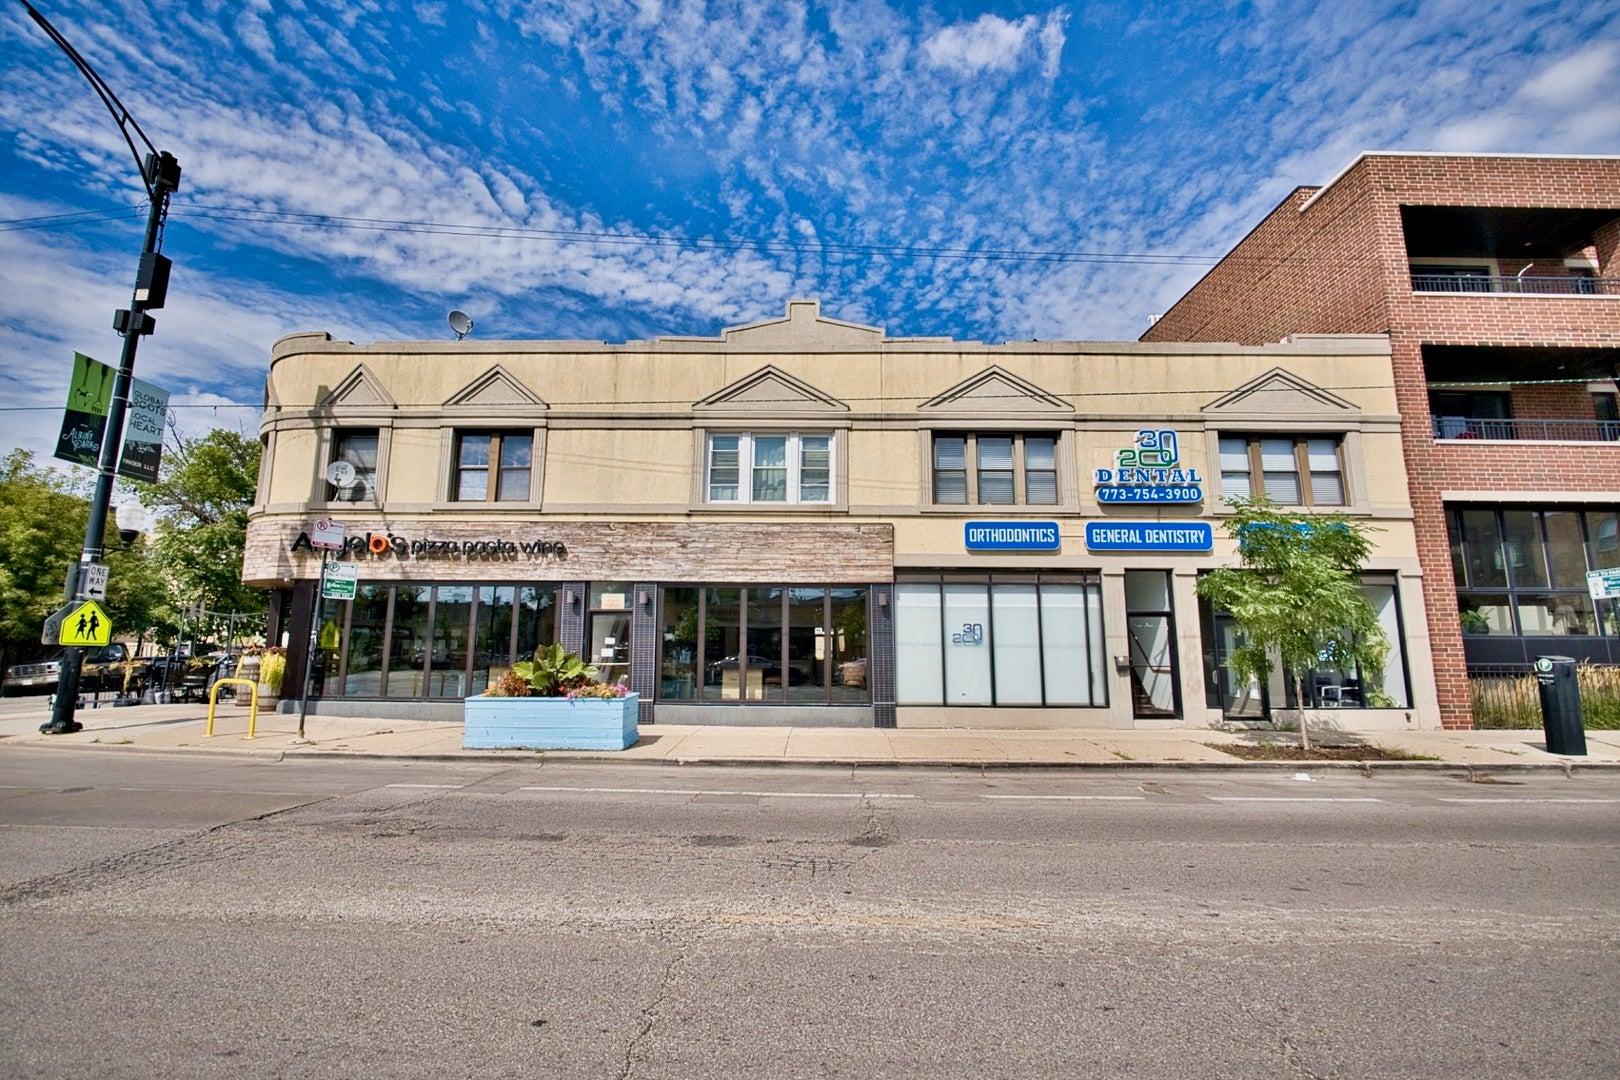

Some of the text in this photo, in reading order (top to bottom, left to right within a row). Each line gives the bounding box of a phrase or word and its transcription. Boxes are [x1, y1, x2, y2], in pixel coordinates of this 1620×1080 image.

[134, 391, 165, 407] GLOBAL
[133, 401, 167, 417] ROOTS
[131, 411, 157, 426] LOCAL
[130, 421, 163, 437] HEART
[143, 463, 155, 471] LLC
[1096, 468, 1202, 483] DENTAL
[1102, 488, 1198, 500] 773-754-3900
[969, 528, 1055, 543] ORTHODONTICS
[1092, 529, 1206, 544] GENERAL DENTISTRY
[411, 538, 458, 555] pizza
[462, 538, 514, 555] pasta
[519, 539, 565, 554] wine
[90, 566, 107, 577] ONE
[88, 577, 105, 586] WAY
[962, 623, 983, 642] 30
